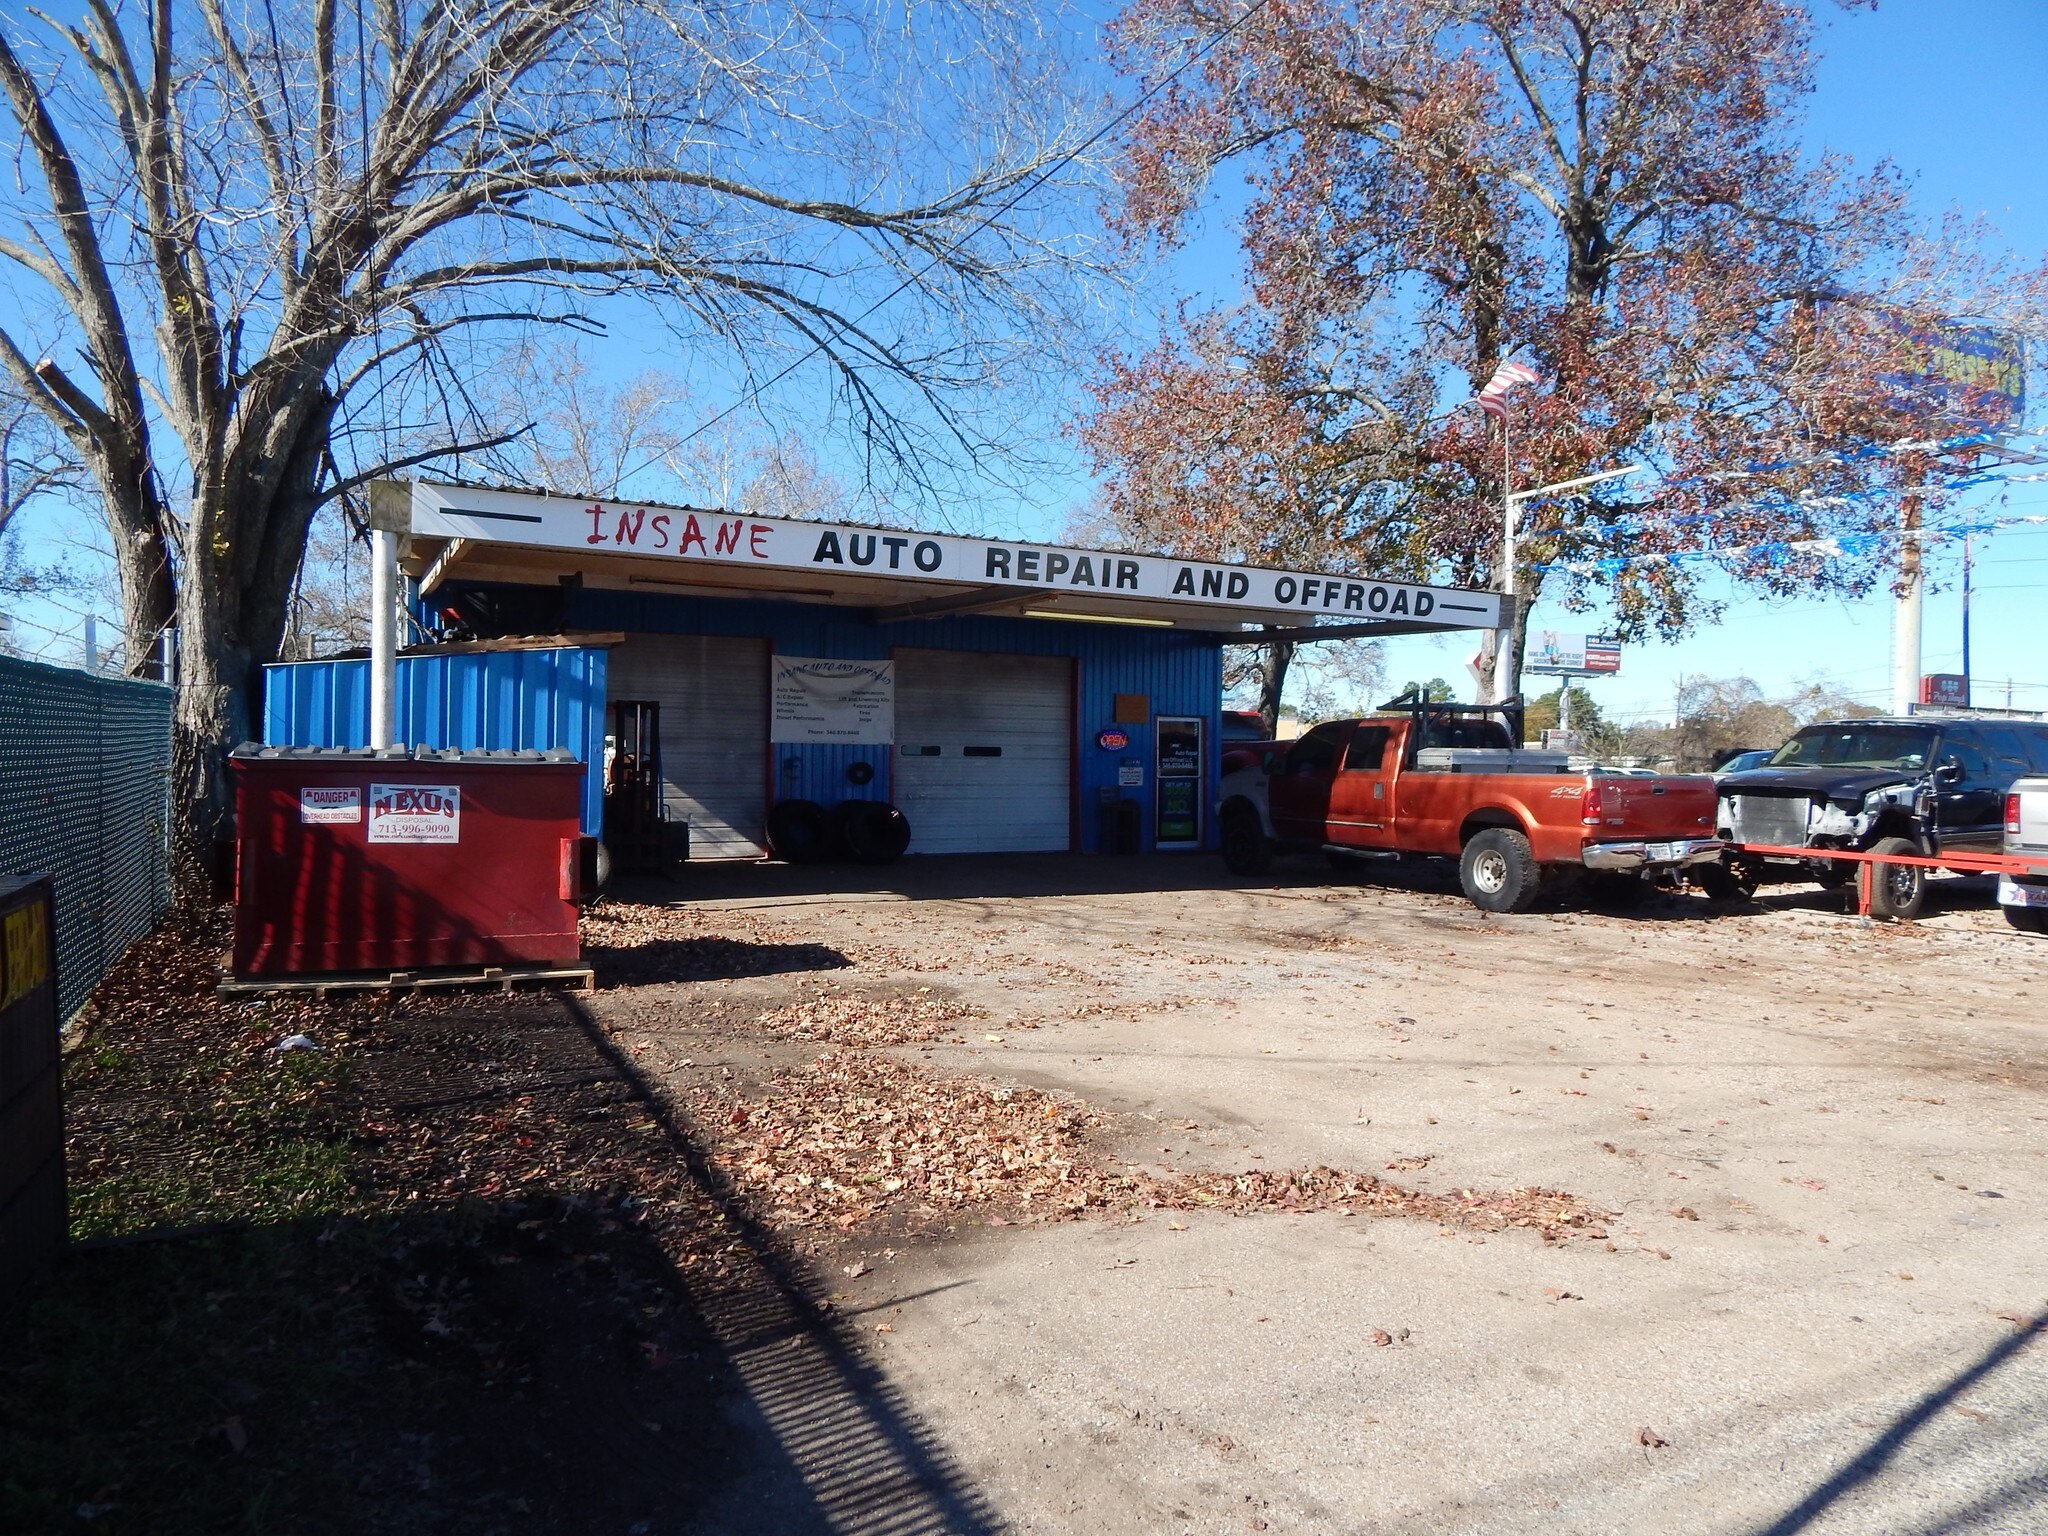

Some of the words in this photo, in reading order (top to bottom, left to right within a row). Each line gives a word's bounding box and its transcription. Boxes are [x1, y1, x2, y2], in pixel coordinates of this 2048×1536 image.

[584, 504, 775, 559] INSANE
[812, 530, 943, 573] AUTO
[985, 546, 1140, 590] REPAIR
[1172, 566, 1251, 600] AND
[1274, 575, 1436, 618] OFFROAD
[777, 664, 809, 683] INSANE
[811, 662, 835, 671] AUTO
[836, 663, 853, 671] AND
[854, 666, 891, 685] OFFROAD
[1100, 734, 1129, 747] OPEN
[1551, 785, 1584, 796] 4x4
[313, 791, 349, 803] DANGER
[373, 788, 456, 820] NEXUS
[304, 812, 330, 820] OVERHEAD
[330, 812, 358, 820] OBSTACLES
[378, 824, 450, 834] 713-996-9090
